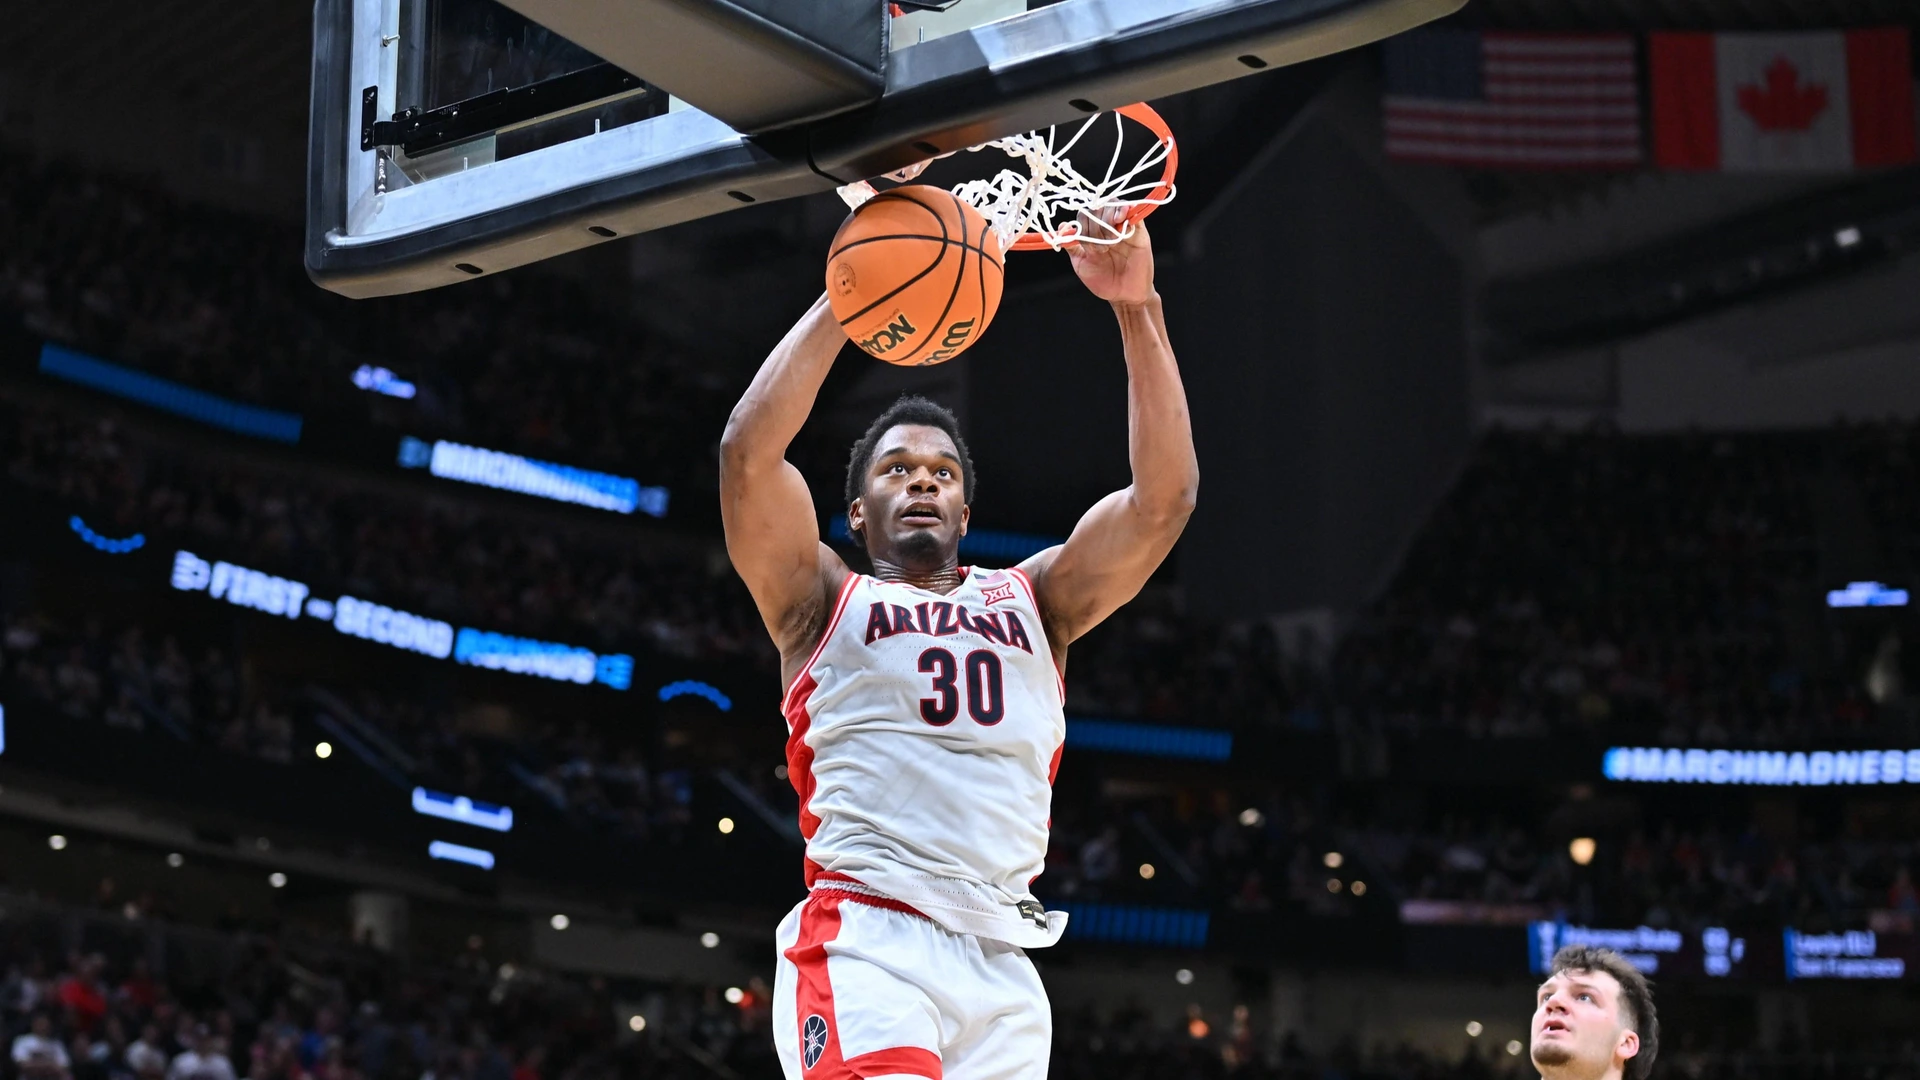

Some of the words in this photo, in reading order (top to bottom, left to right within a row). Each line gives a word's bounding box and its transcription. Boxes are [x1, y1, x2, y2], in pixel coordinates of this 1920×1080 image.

[209, 560, 310, 620] FIRST
[333, 594, 455, 660] SECOND
[865, 601, 1034, 656] ARIZONA
[917, 646, 1005, 727] 30
[1602, 746, 1920, 786] #MARCHMADNESS
